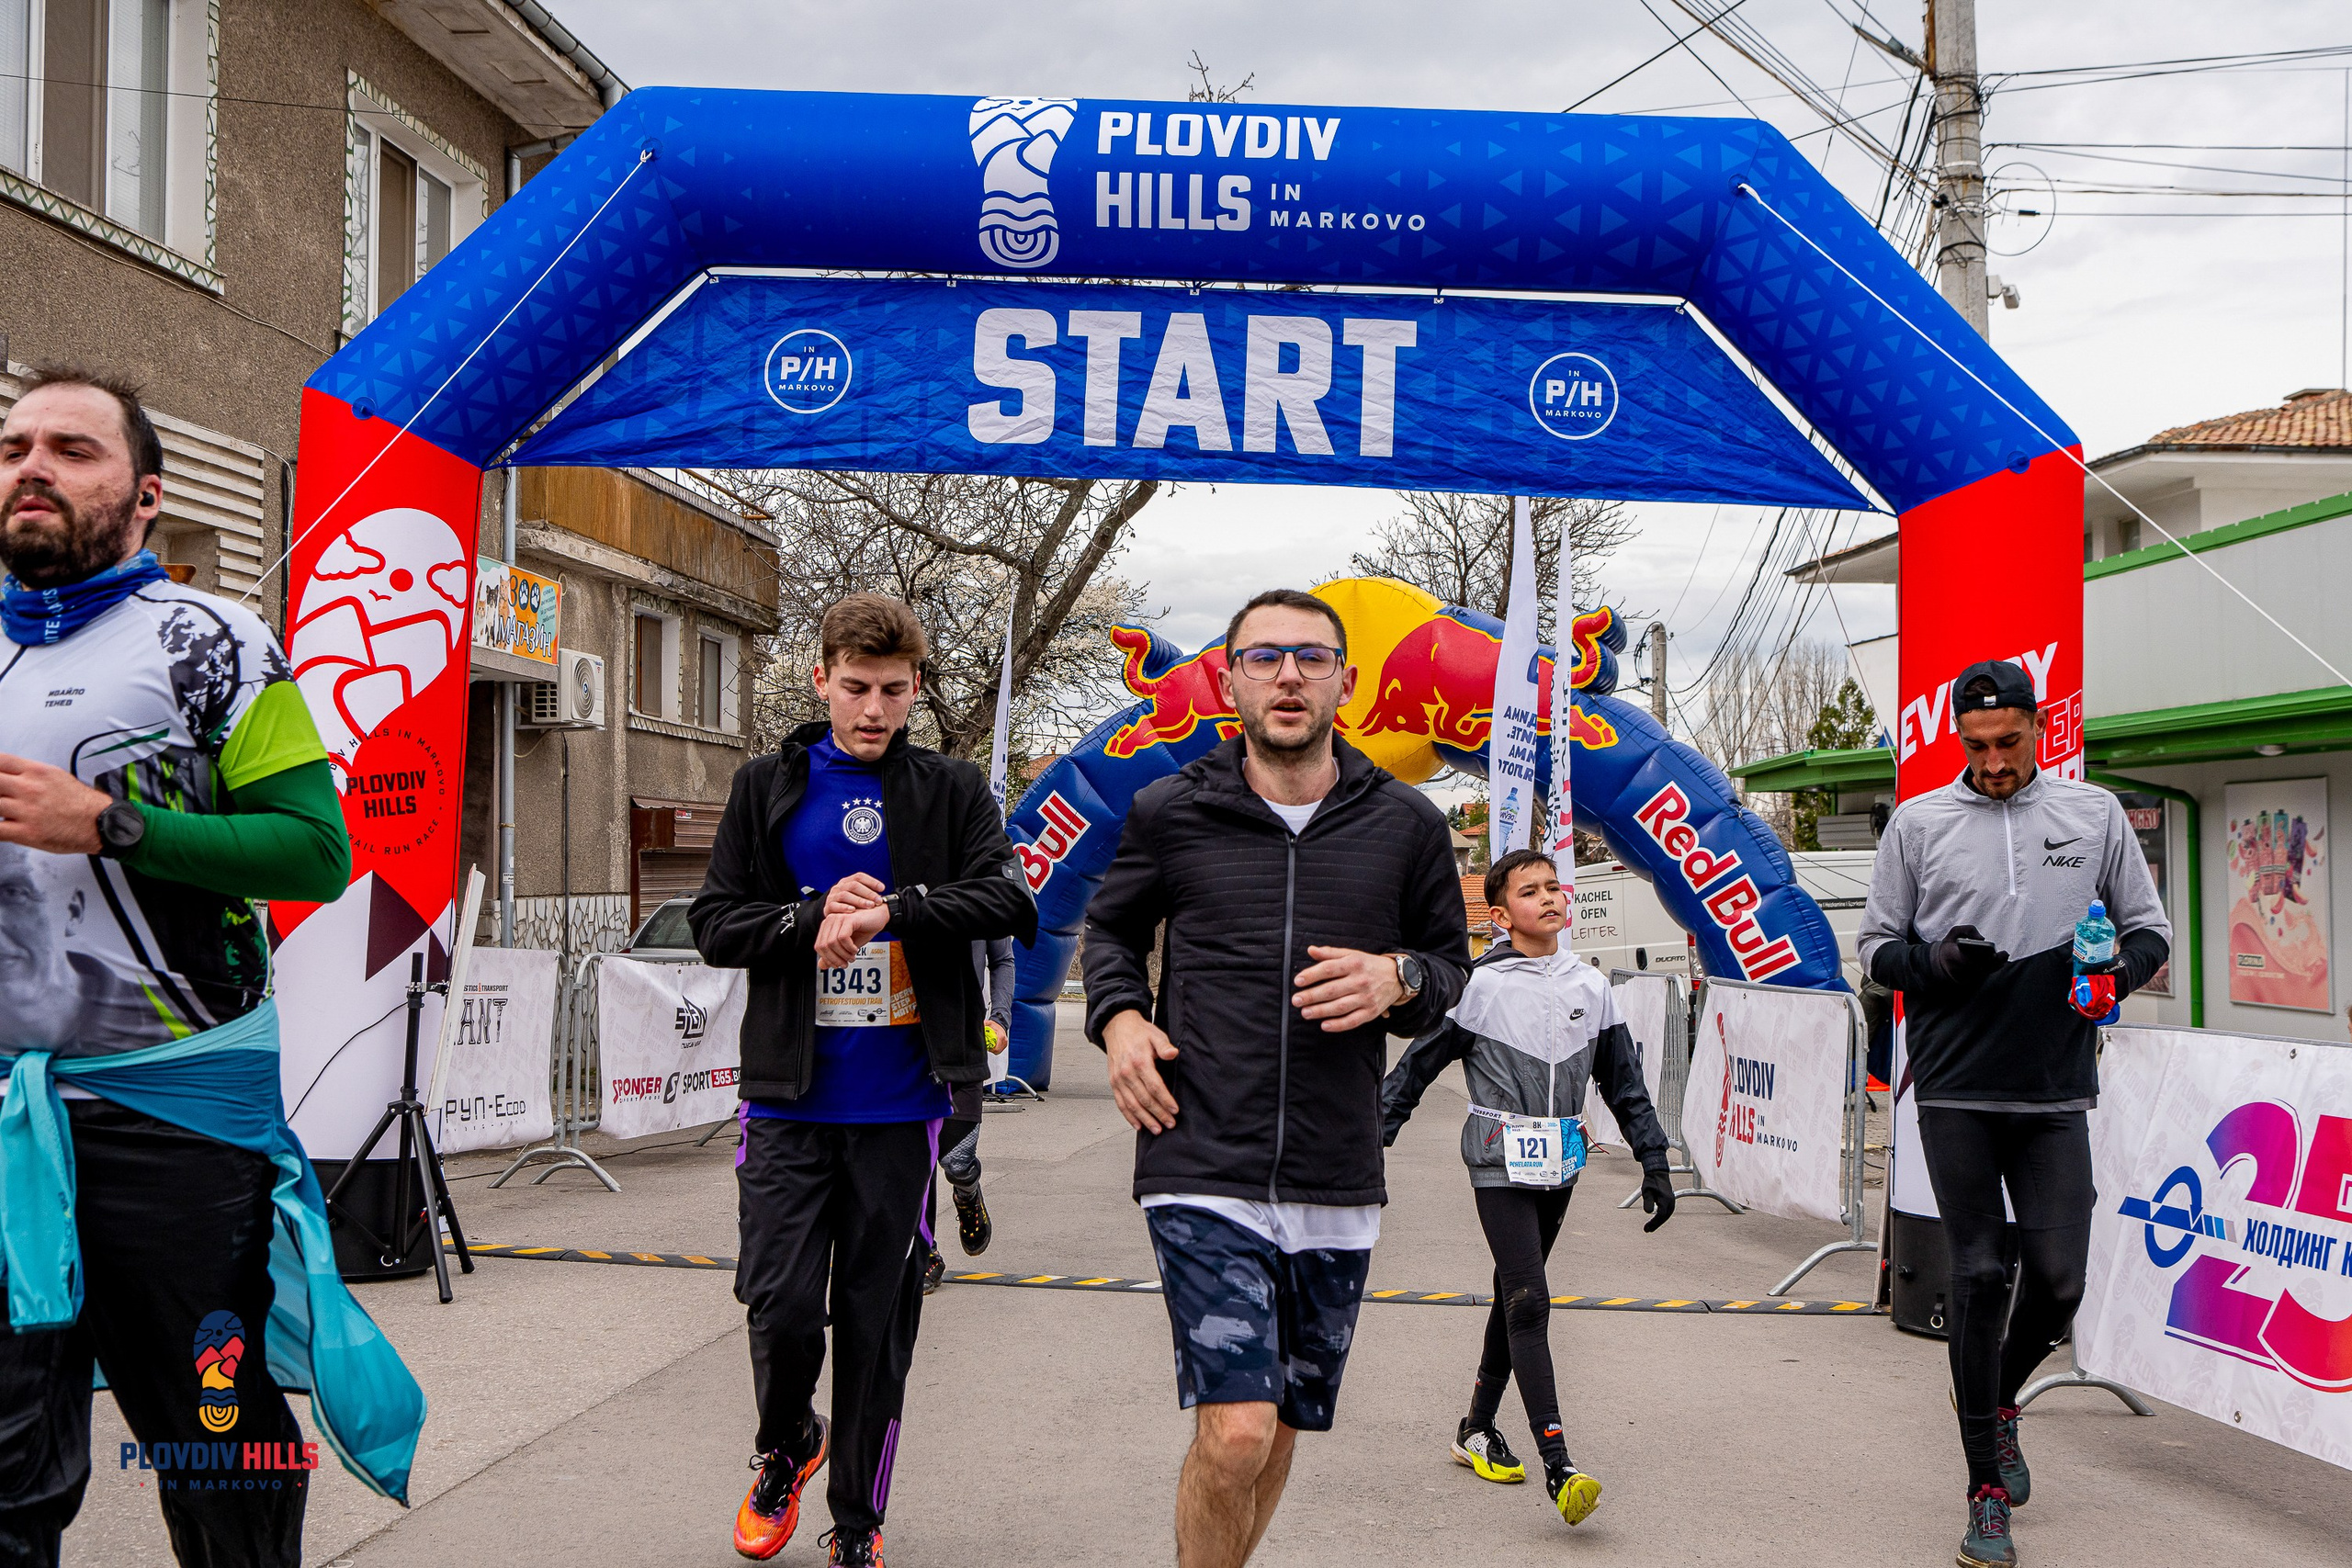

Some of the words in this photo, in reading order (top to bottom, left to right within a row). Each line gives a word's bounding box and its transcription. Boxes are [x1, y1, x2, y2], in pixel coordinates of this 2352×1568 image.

[1099, 111, 1341, 161] PLOVDIV
[1096, 171, 1251, 231] HILLS
[1271, 184, 1301, 201] IN
[1270, 210, 1426, 231] MARKOVO
[780, 356, 837, 381] P/H
[1569, 369, 1580, 378] IN
[779, 384, 834, 392] MARKOVO
[967, 308, 1418, 457] START
[1545, 379, 1602, 408] P/H
[1545, 410, 1601, 418] MARKOVO
[497, 615, 551, 657] МАГАЗИН
[1900, 641, 2058, 765] EVY
[398, 728, 412, 739] IN
[417, 737, 446, 795] MARKOVO
[345, 770, 426, 796] PLOVDIV
[363, 795, 417, 819] HILLS
[348, 832, 375, 853] RAIL
[384, 844, 411, 855] RUN
[415, 818, 439, 846] RACE
[1013, 792, 1090, 894] Bull
[2042, 855, 2086, 868] NIKE
[1634, 782, 1740, 892] Red
[1703, 874, 1801, 982] Bull
[1575, 890, 1613, 904] KACHEL
[1580, 907, 1607, 919] ÖFEN
[1571, 926, 1618, 940] LEITER
[1656, 955, 1686, 964] DUCATO
[820, 967, 882, 995] 1343
[613, 1077, 662, 1104] SPONSER
[1758, 1114, 1765, 1127] IN
[1517, 1138, 1547, 1158] 121
[1757, 1132, 1798, 1152] MARKOVO
[2243, 1217, 2336, 1270] ХОЛДИНГ
